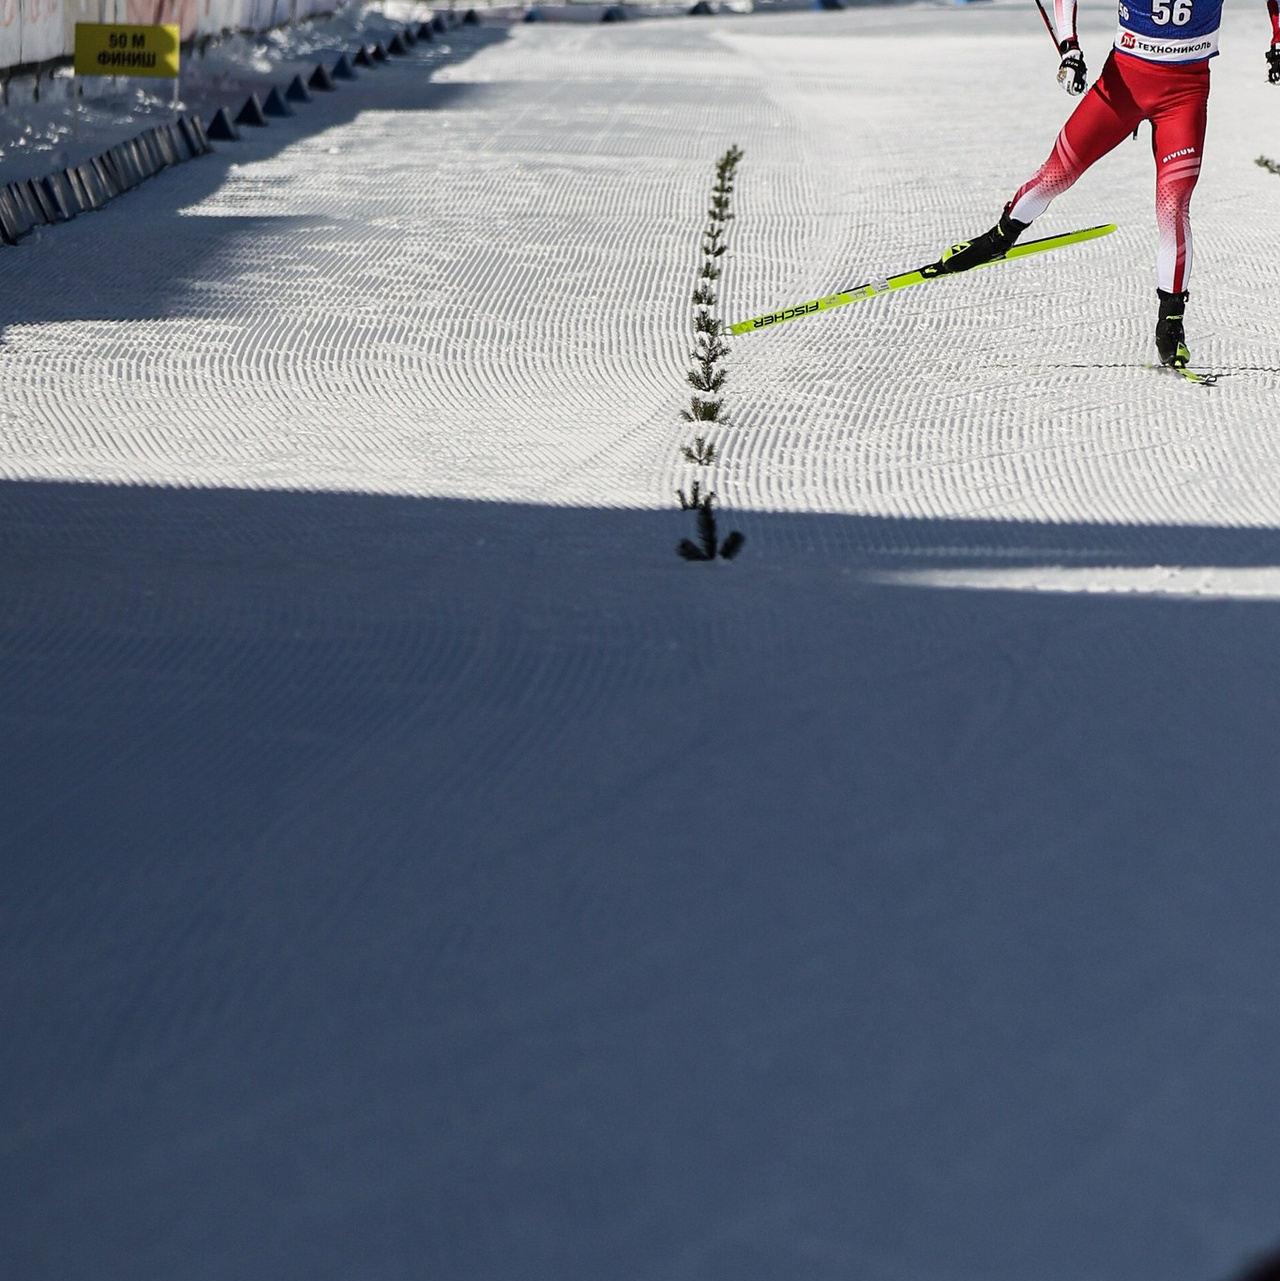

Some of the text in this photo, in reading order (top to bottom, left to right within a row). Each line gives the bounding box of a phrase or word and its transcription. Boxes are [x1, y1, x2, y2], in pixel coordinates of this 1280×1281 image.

[1119, 2, 1130, 21] 56
[109, 33, 146, 49] 50 М
[1137, 42, 1212, 54] ТЕХНОНИКОЛЬ
[97, 51, 156, 68] ФИНИШ
[753, 301, 820, 328] FISCHER
